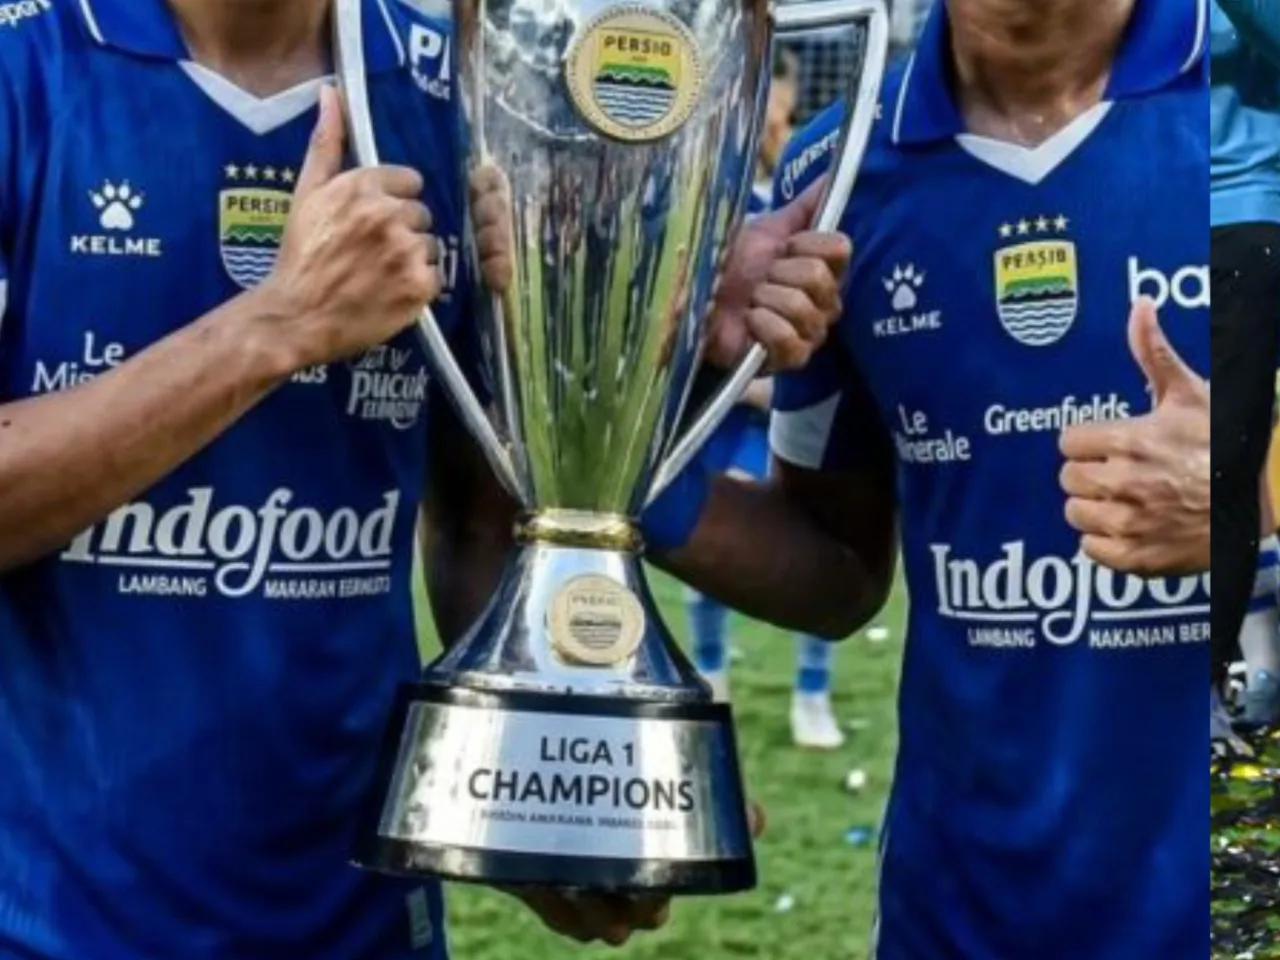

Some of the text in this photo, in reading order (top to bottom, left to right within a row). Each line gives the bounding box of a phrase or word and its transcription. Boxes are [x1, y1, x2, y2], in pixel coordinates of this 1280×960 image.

[71, 235, 162, 257] KELME
[873, 310, 943, 338] KELME
[84, 332, 124, 366] Le
[984, 392, 1131, 435] Greenfields
[119, 574, 207, 597] LAMBANG
[540, 736, 634, 766] LIGA 1
[467, 769, 695, 811] CHAMPIONS
